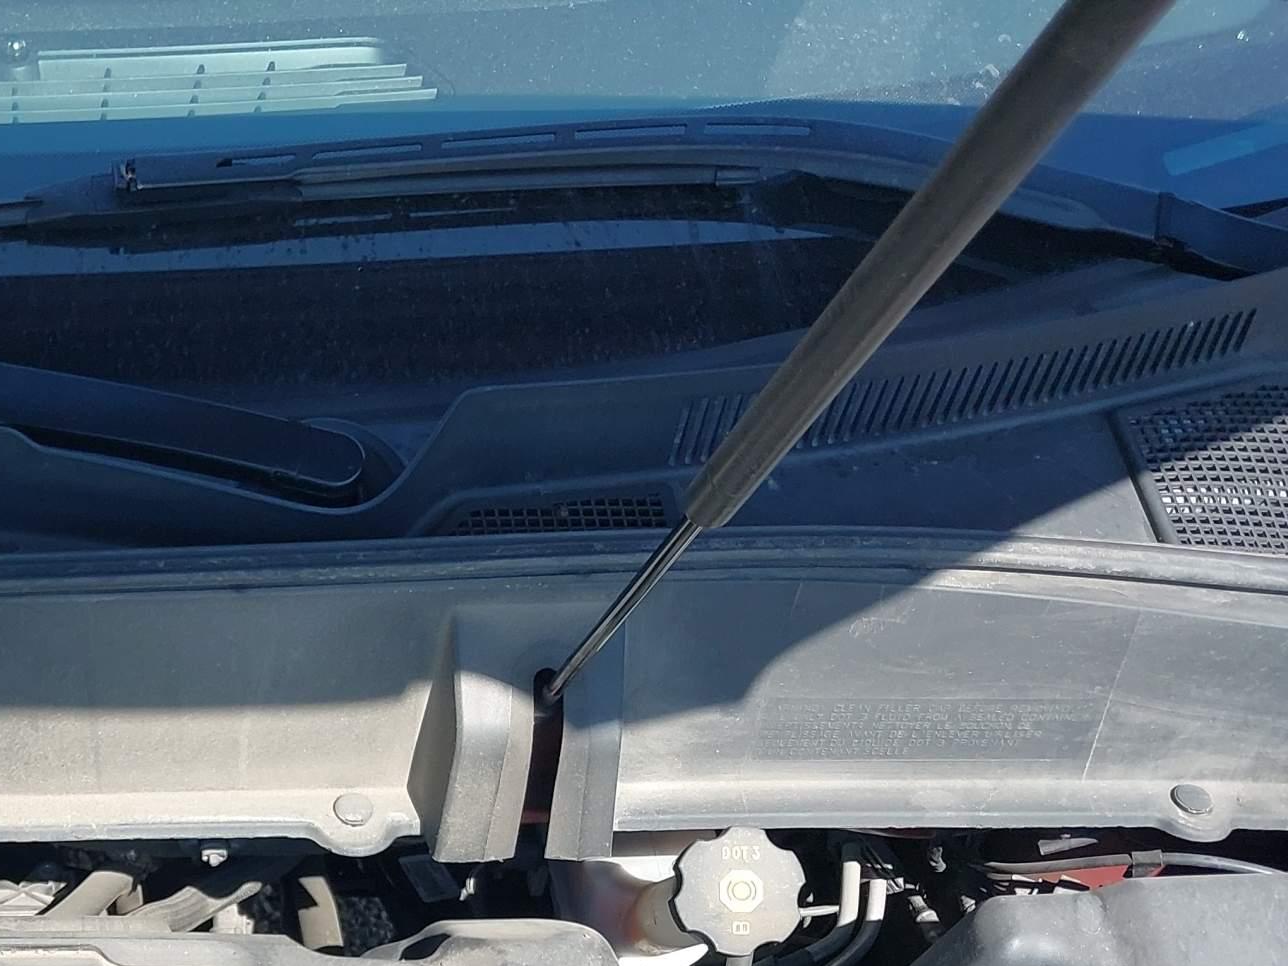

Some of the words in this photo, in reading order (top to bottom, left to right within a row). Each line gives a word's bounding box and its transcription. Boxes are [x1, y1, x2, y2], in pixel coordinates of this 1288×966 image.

[876, 703, 922, 713] FILLER
[829, 712, 853, 722] DOT
[874, 712, 912, 722] FLUID
[917, 712, 949, 722] FROM
[721, 845, 748, 861] DOT
